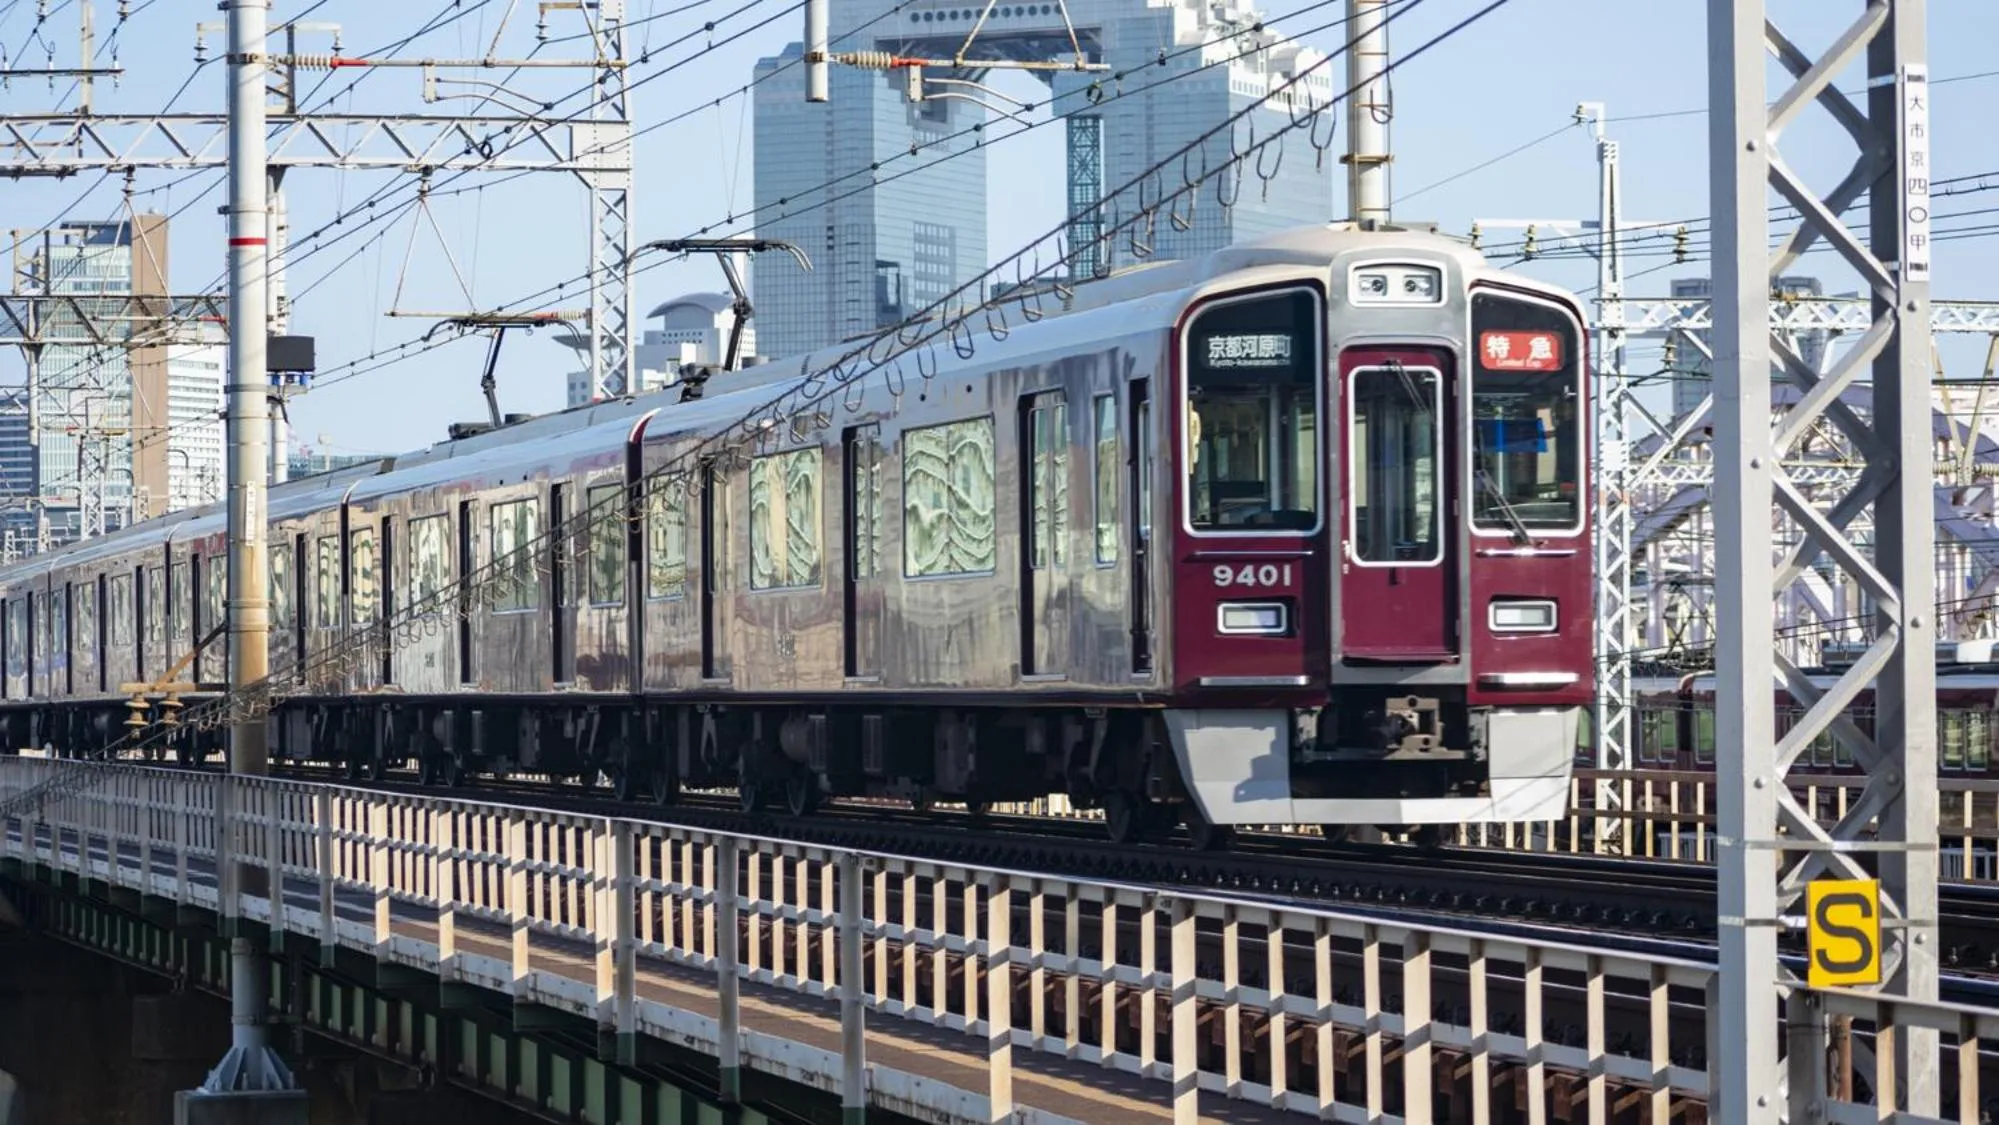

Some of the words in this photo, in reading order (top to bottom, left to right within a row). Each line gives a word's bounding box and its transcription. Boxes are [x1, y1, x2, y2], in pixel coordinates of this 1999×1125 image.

[1208, 335, 1291, 358] 京都河原町
[1213, 564, 1291, 587] 9401
[1815, 893, 1873, 974] S
